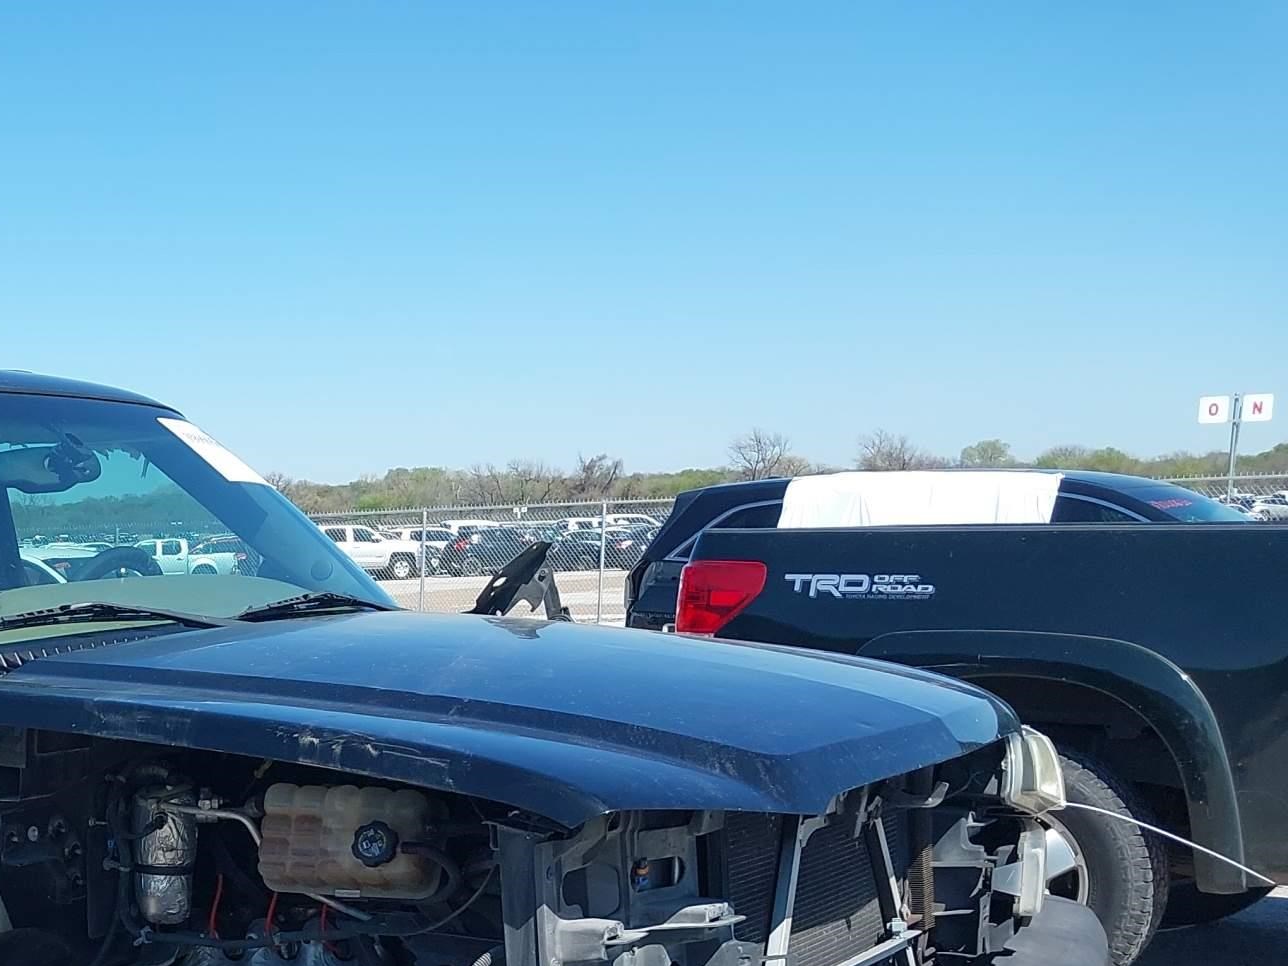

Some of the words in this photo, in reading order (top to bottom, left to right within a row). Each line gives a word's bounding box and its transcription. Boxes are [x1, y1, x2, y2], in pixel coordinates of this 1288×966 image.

[1252, 401, 1263, 414] N
[784, 574, 869, 598] TRD
[873, 575, 920, 583] OFF
[871, 585, 935, 593] ROAD
